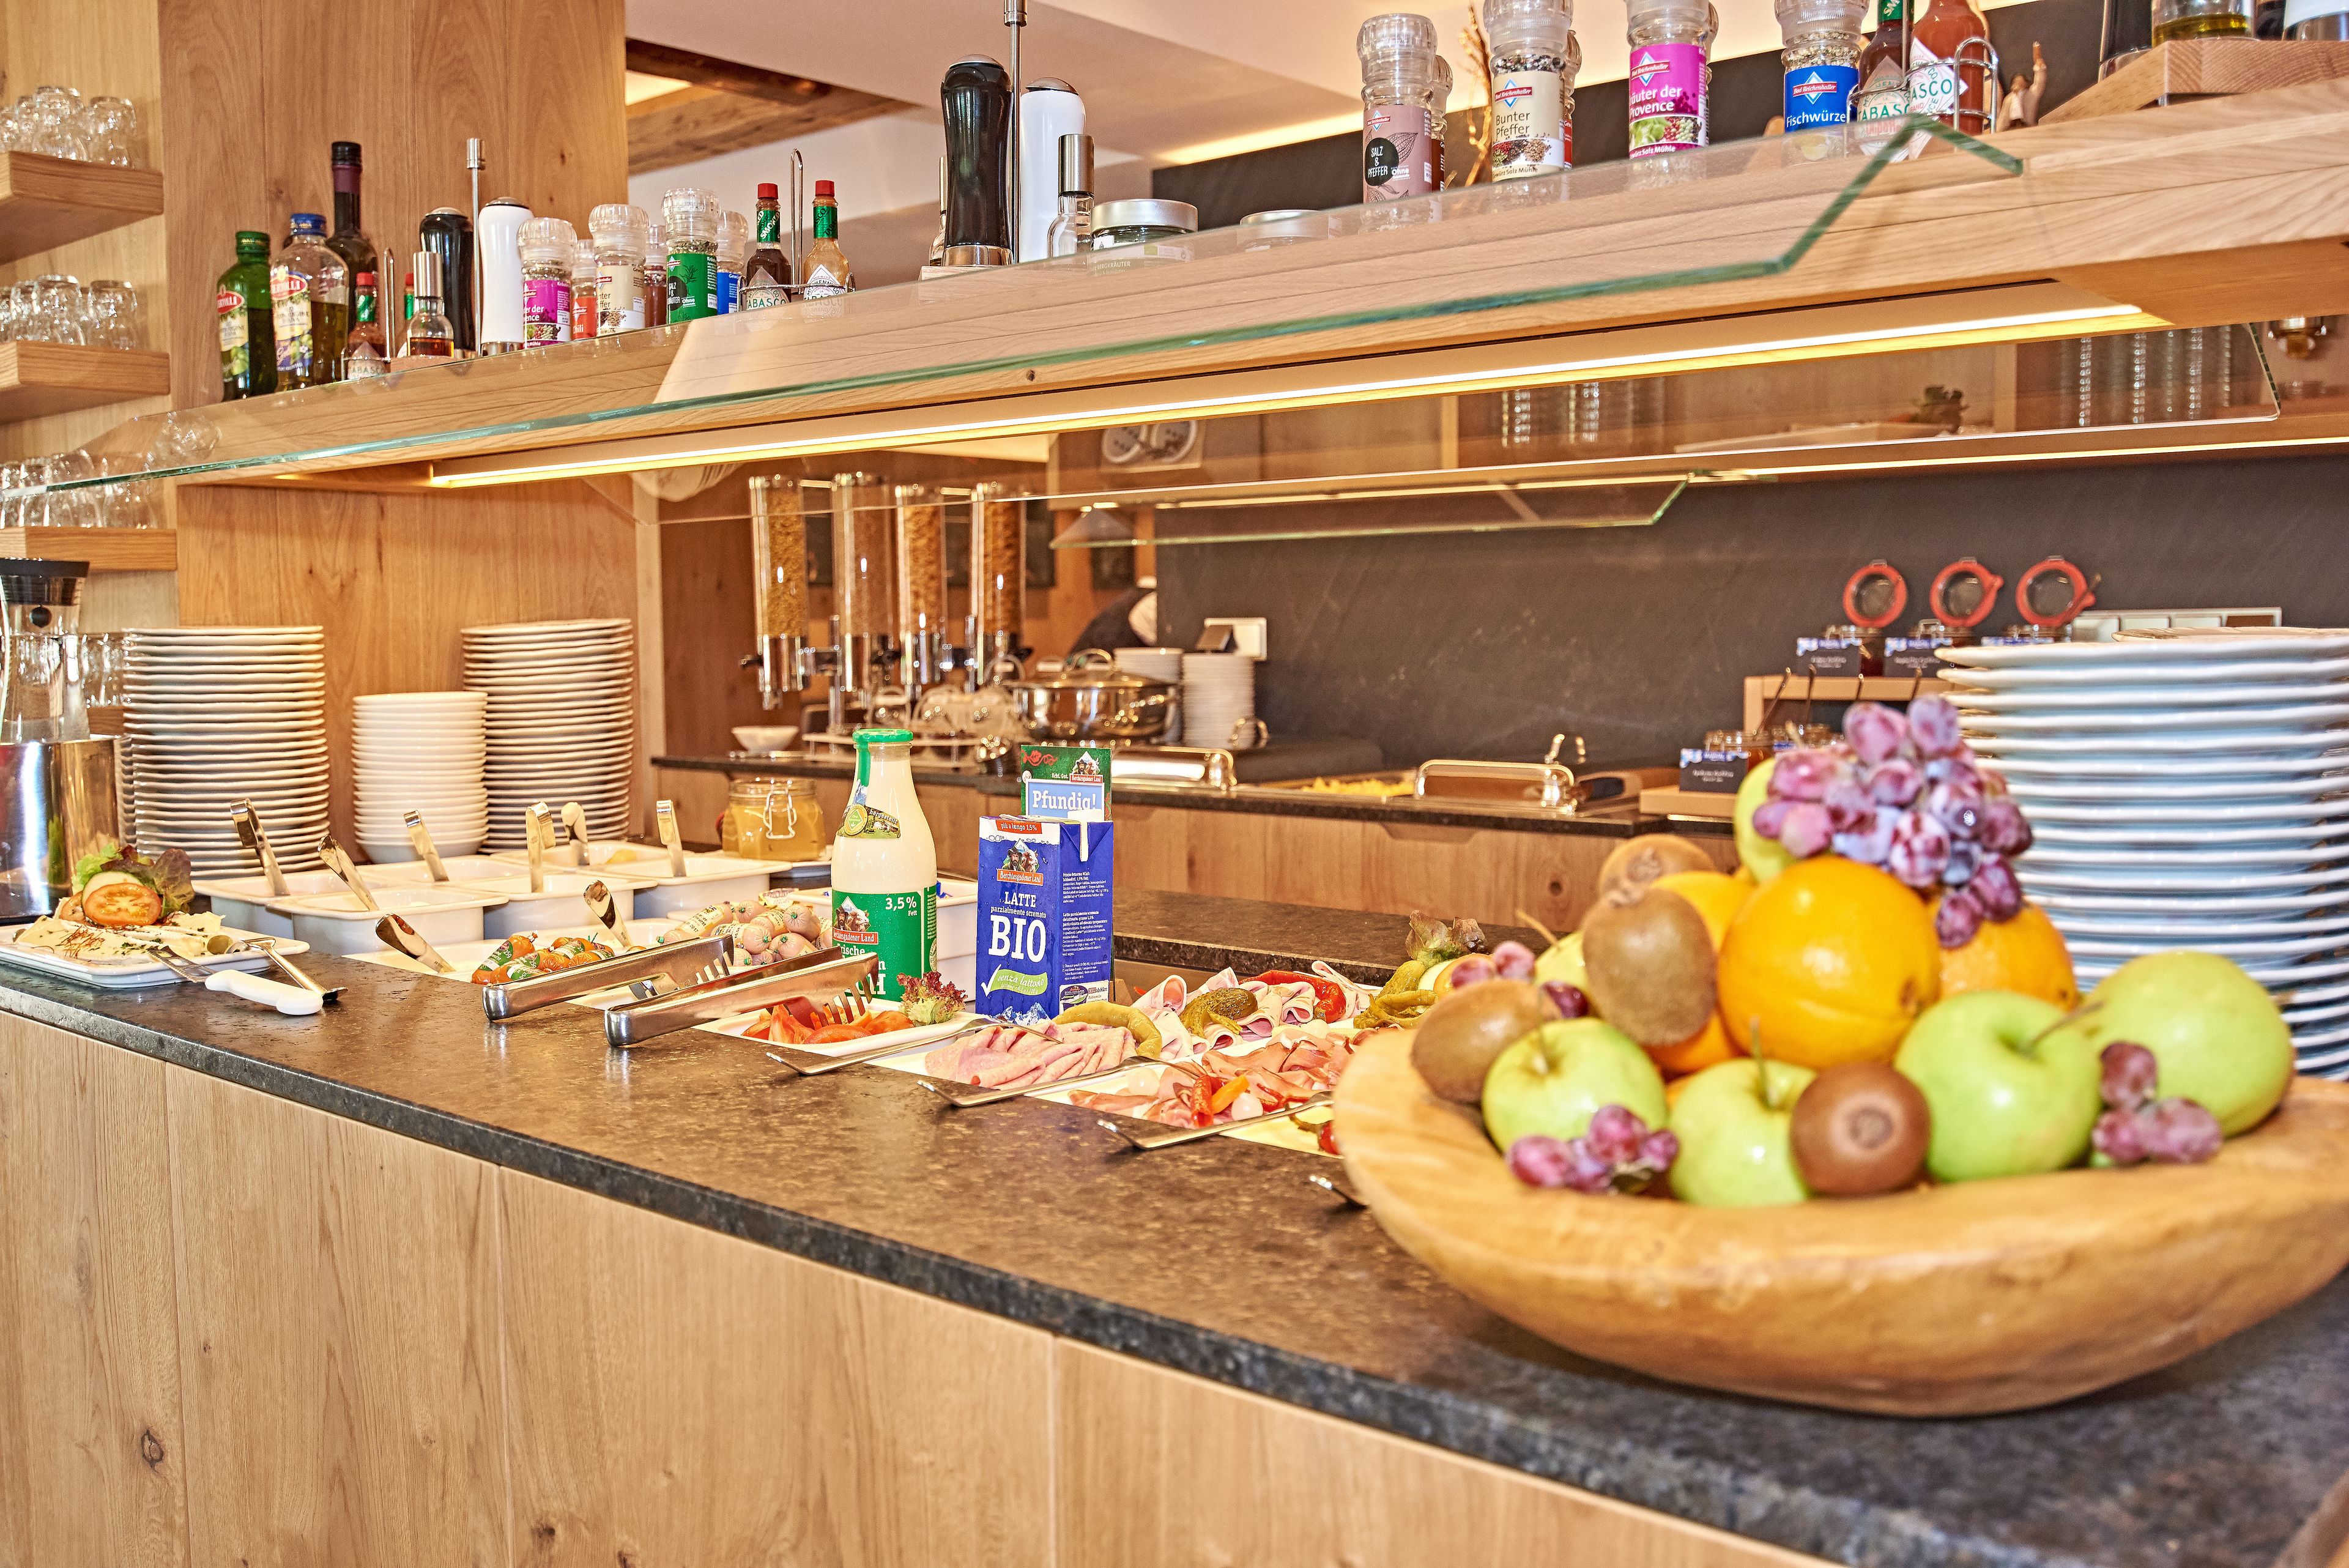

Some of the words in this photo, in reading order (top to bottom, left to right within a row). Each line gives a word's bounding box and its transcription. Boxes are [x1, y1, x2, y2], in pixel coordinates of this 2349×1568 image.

[1501, 89, 1532, 98] Reichenhaller
[1630, 89, 1657, 105] räuter
[1660, 84, 1682, 98] der
[1912, 79, 1953, 99] ASCO
[1496, 111, 1531, 127] Bunter
[1786, 110, 1846, 128] Fischwürze
[1496, 123, 1530, 141] Pfeffer
[1371, 146, 1384, 158] SALZ
[1655, 144, 1677, 154] Mühle
[1375, 157, 1379, 166] &
[1368, 165, 1388, 178] PFEFFER
[747, 298, 786, 309] ABASCO
[869, 809, 898, 824] hergestellt
[1012, 822, 1026, 831] lungo
[1000, 870, 1033, 882] Berchtesgadener
[1032, 874, 1041, 883] Land
[1004, 891, 1036, 908] LATTE
[990, 906, 1025, 916] parzialmente
[833, 931, 860, 943] erchtesgadener
[861, 934, 875, 943] Land
[989, 914, 1047, 963] BIO
[997, 975, 1019, 983] senza
[1020, 975, 1044, 987] lattosio
